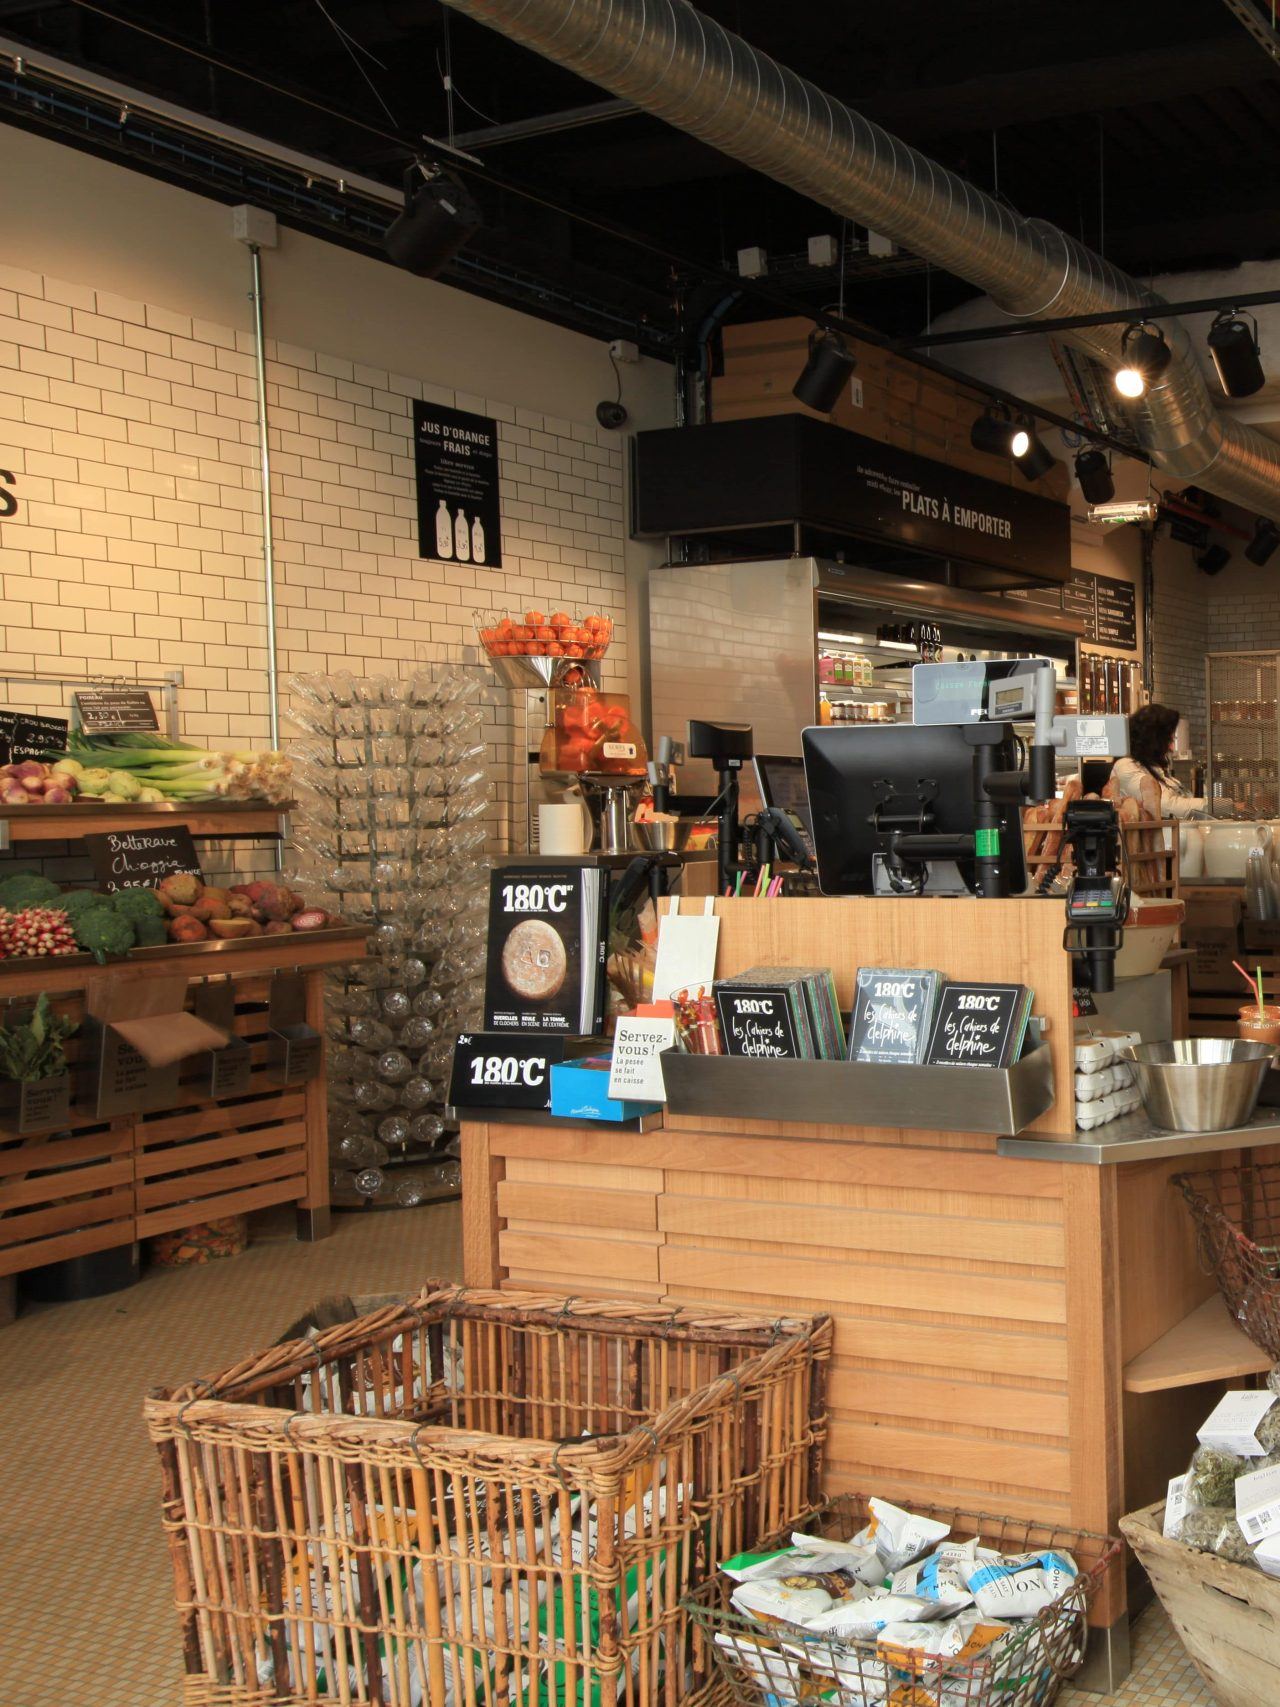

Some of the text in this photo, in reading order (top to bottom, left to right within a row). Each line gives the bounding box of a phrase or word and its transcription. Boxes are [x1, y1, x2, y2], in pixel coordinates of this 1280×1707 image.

[421, 421, 440, 434] JUS
[443, 425, 490, 446] D'ORANGE
[443, 440, 471, 456] FRAIS
[902, 490, 1011, 540] PLATS À EMPORTER
[503, 885, 567, 912] 180°C
[874, 982, 915, 998] 180°C
[733, 999, 773, 1014] 180°C
[958, 995, 1000, 1011] 180°C
[775, 1020, 784, 1038] de
[990, 1017, 1001, 1034] de
[619, 1030, 668, 1043] Servez-
[946, 1030, 996, 1058] delphine
[742, 1034, 788, 1058] delphine
[470, 1057, 546, 1086] 180°C
[623, 1076, 644, 1084] caisse
